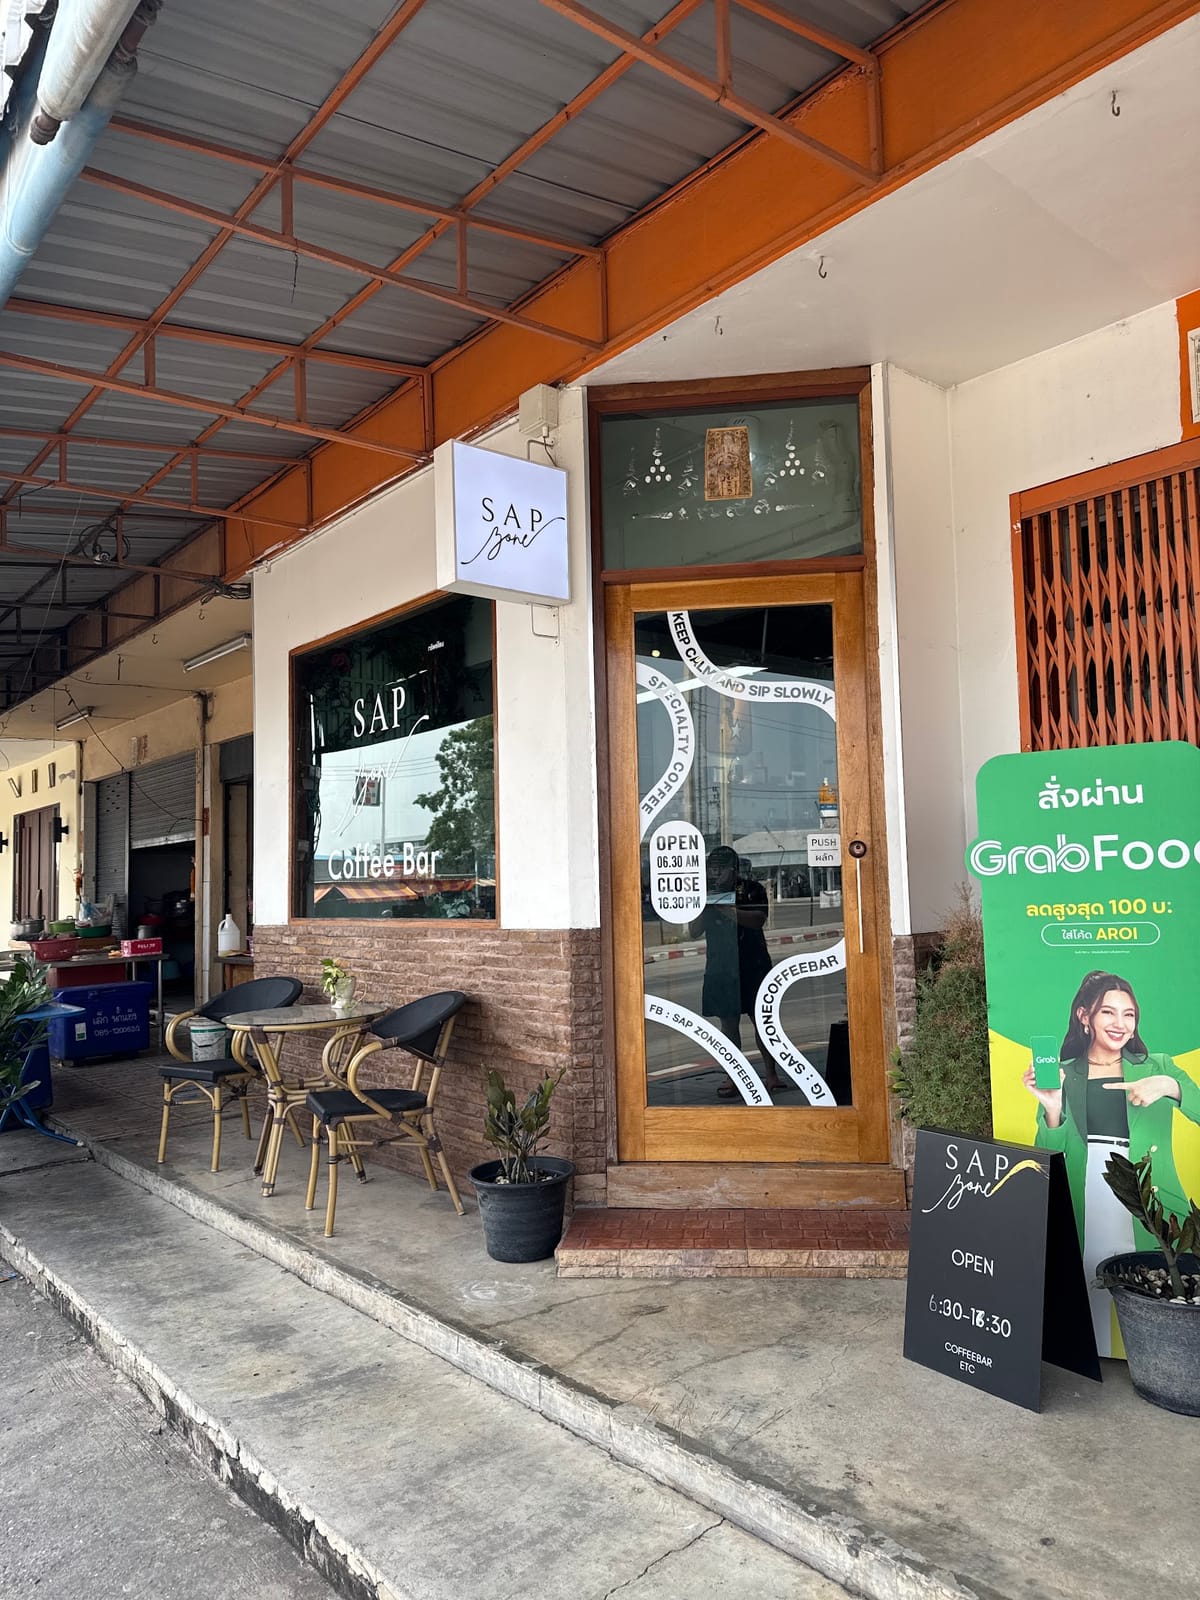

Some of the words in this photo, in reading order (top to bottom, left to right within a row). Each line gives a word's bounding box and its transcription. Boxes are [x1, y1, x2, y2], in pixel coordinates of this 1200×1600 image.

[481, 497, 543, 532] SAP
[672, 612, 691, 645] KEEP
[685, 648, 719, 680] CALM
[716, 676, 746, 693] AND
[748, 685, 771, 697] SIP
[773, 686, 833, 706] SLOWLY
[353, 686, 406, 738] SAP
[648, 675, 689, 755] SPECIALTY
[641, 761, 685, 815] COFFEE
[1038, 775, 1144, 810] สั่งผ่าน
[656, 834, 699, 851] OPEN
[811, 838, 837, 847] PUSH
[970, 833, 1200, 877] GrabFoo
[327, 842, 395, 881] Coffee
[403, 842, 440, 879] Bar
[657, 855, 683, 869] 06.30
[685, 855, 699, 868] AM
[815, 852, 834, 862] ผลัก
[657, 876, 700, 893] CLOSE
[1026, 902, 1105, 921] ลดสูงสุด
[1108, 898, 1147, 915] 100
[1096, 926, 1138, 941] AROI
[649, 1004, 664, 1016] FB
[672, 1013, 694, 1028] SAP
[693, 1026, 762, 1105] ZONECOFFEEBAR
[1035, 1055, 1057, 1064] Grab
[810, 1082, 826, 1100] IG
[945, 1144, 1009, 1180] SAP
[951, 1249, 994, 1277] OPEN
[944, 1341, 993, 1368] COFFEEBAR
[959, 1360, 976, 1374] ETC
